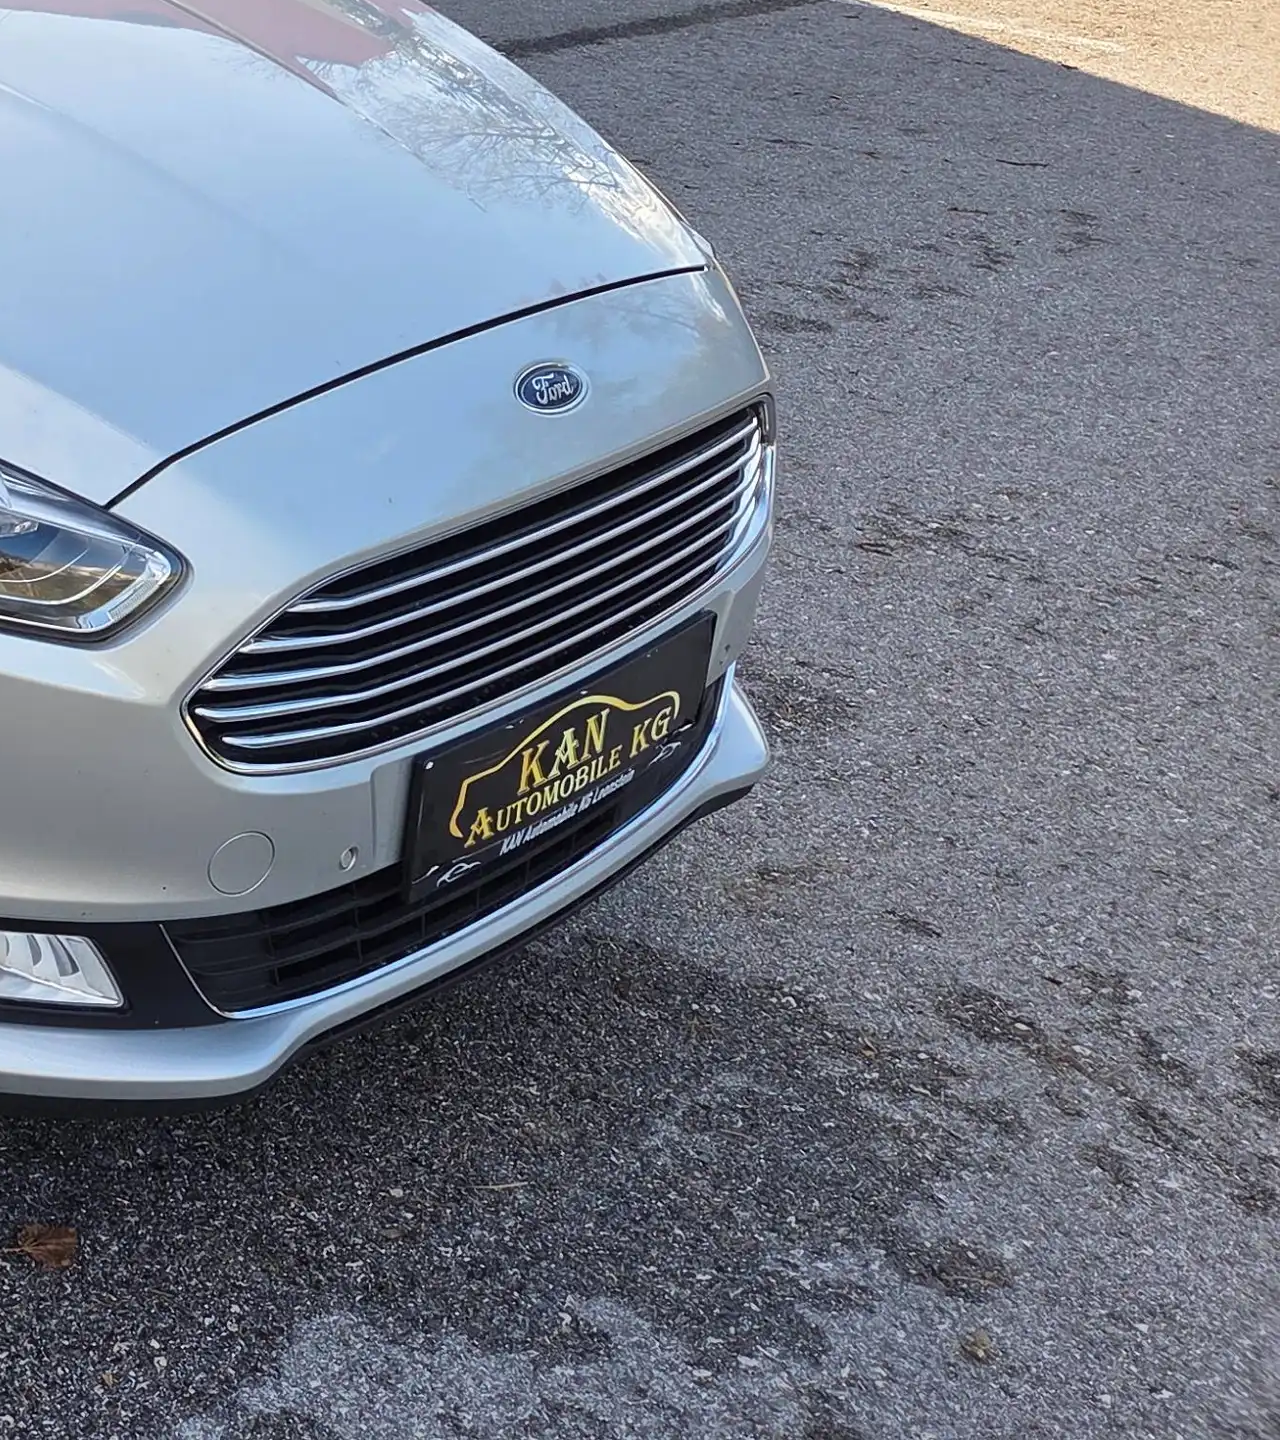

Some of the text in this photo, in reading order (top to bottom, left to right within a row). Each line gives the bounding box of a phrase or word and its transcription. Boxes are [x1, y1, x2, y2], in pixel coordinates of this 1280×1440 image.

[532, 372, 574, 405] Ford
[464, 707, 672, 848] AUTOMOBILE KG
[517, 708, 610, 795] KAN
[499, 832, 526, 856] KAN
[522, 801, 580, 844] Automobile
[577, 791, 594, 813] KG
